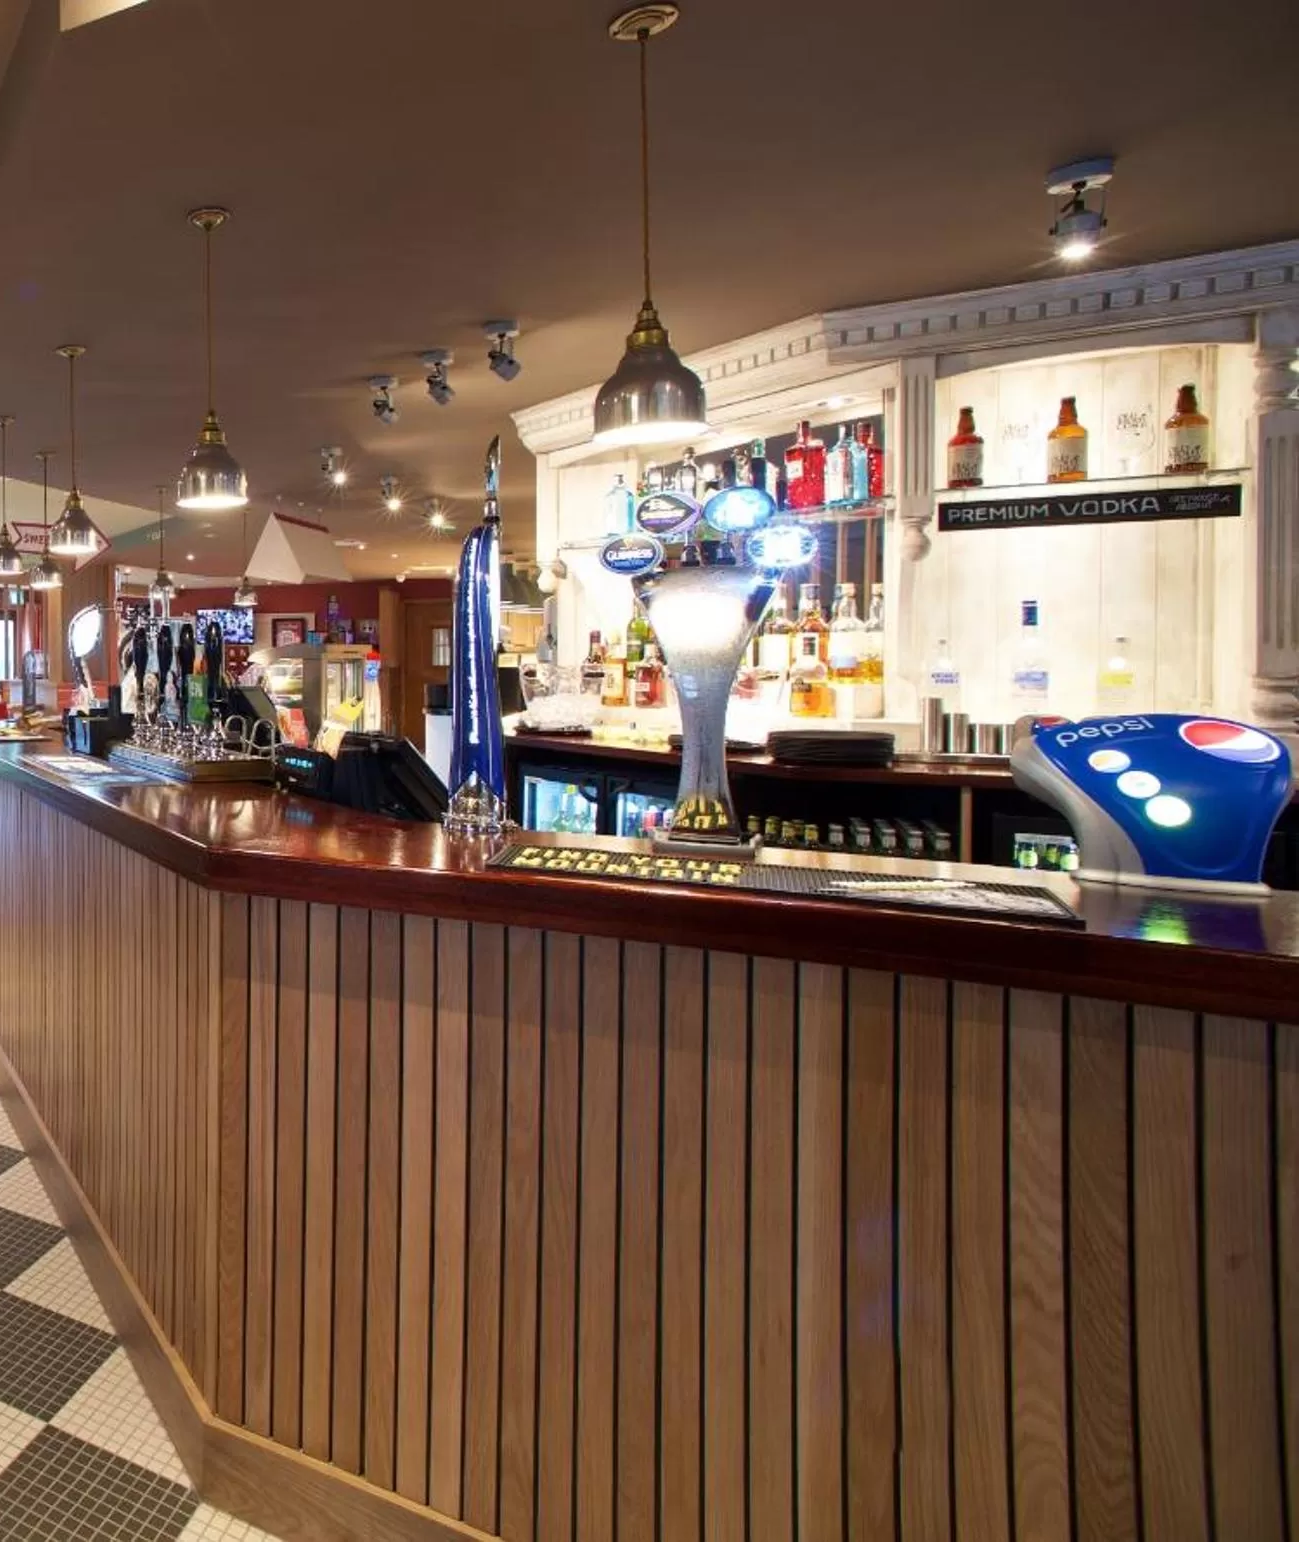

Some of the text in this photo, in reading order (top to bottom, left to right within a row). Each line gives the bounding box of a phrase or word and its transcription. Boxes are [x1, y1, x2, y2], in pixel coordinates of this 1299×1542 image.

[947, 496, 1161, 523] PREMIUM VODKA
[1055, 717, 1156, 748] pepsi
[511, 856, 736, 884] MOUNTAIN
[522, 847, 743, 875] FIND YOUR
